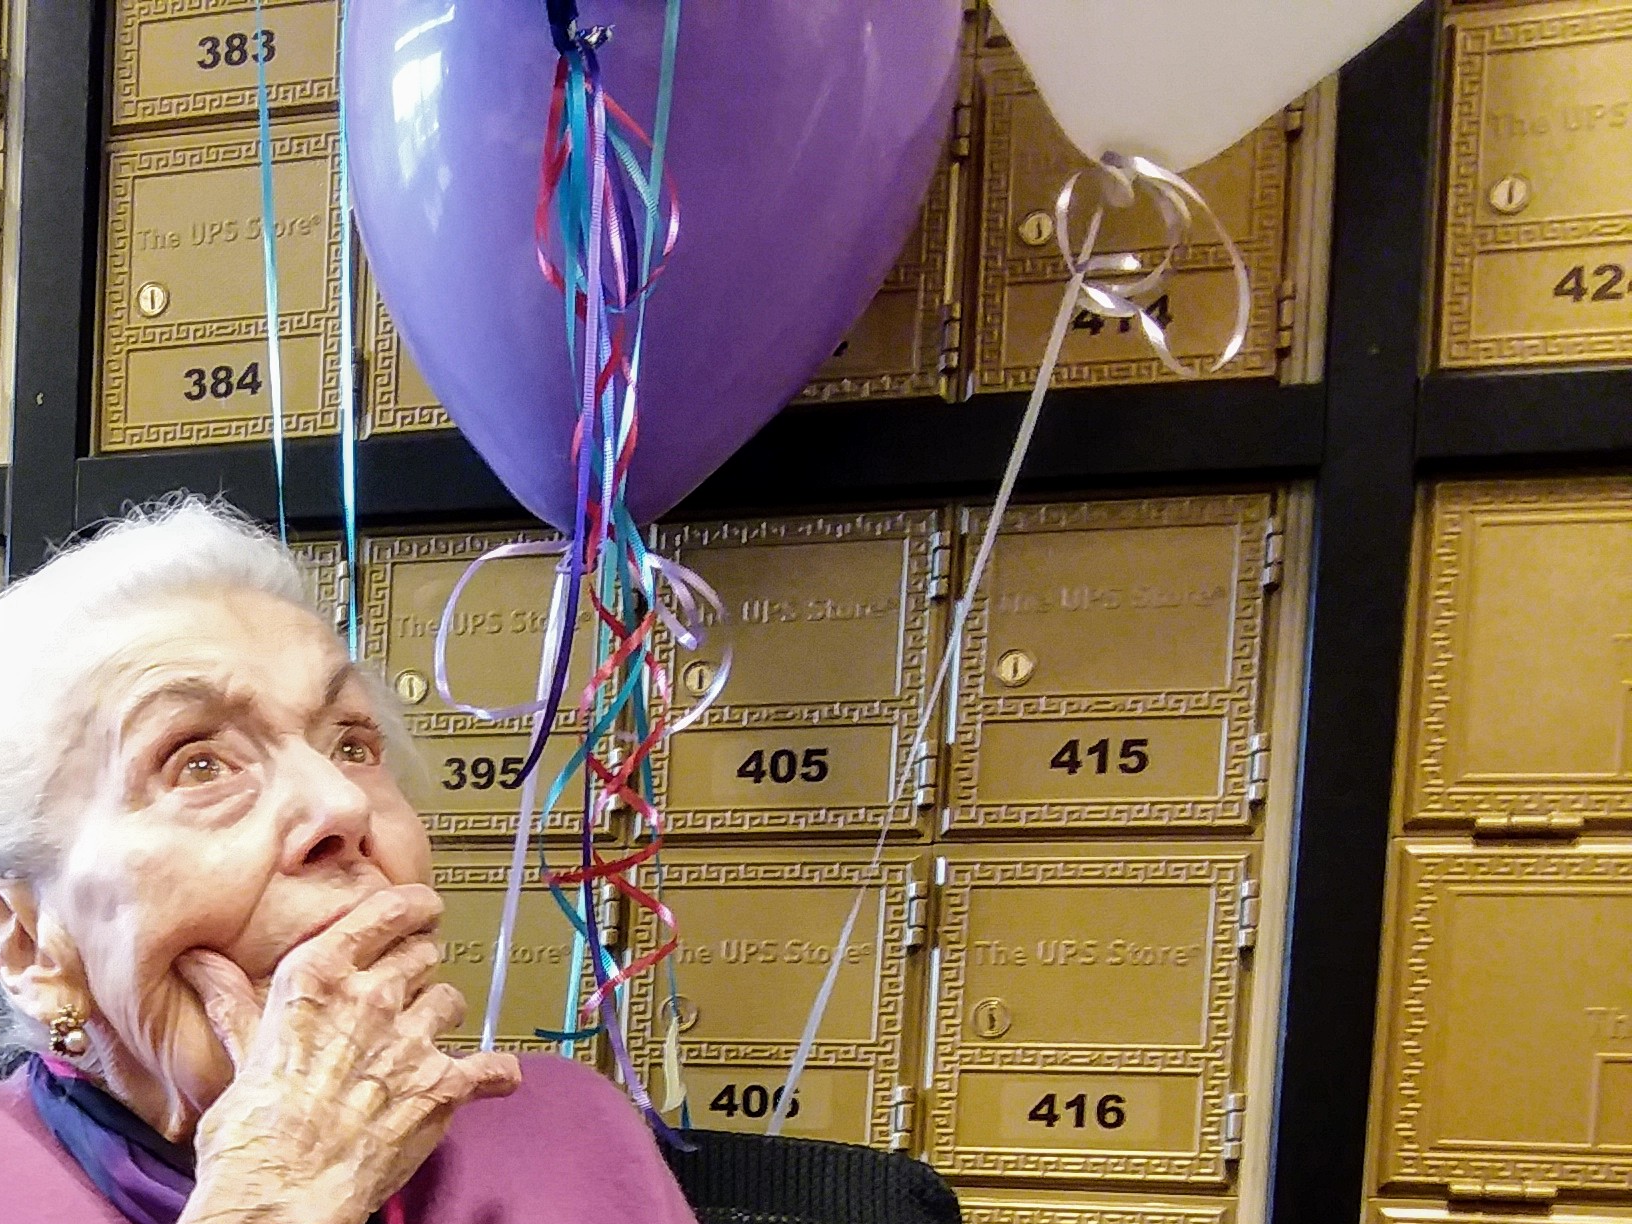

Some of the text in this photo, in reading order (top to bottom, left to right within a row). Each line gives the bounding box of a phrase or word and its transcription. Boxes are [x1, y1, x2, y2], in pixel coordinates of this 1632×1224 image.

[198, 30, 275, 69] 383
[137, 214, 313, 251] The UPS Sore
[1553, 264, 1632, 302] 42
[184, 363, 261, 401] 384
[442, 756, 525, 791] 395
[738, 748, 828, 783] 405
[1050, 739, 1148, 774] 415
[974, 939, 1026, 966] The
[1038, 940, 1097, 966] UPS
[1029, 1094, 1125, 1129] 416
